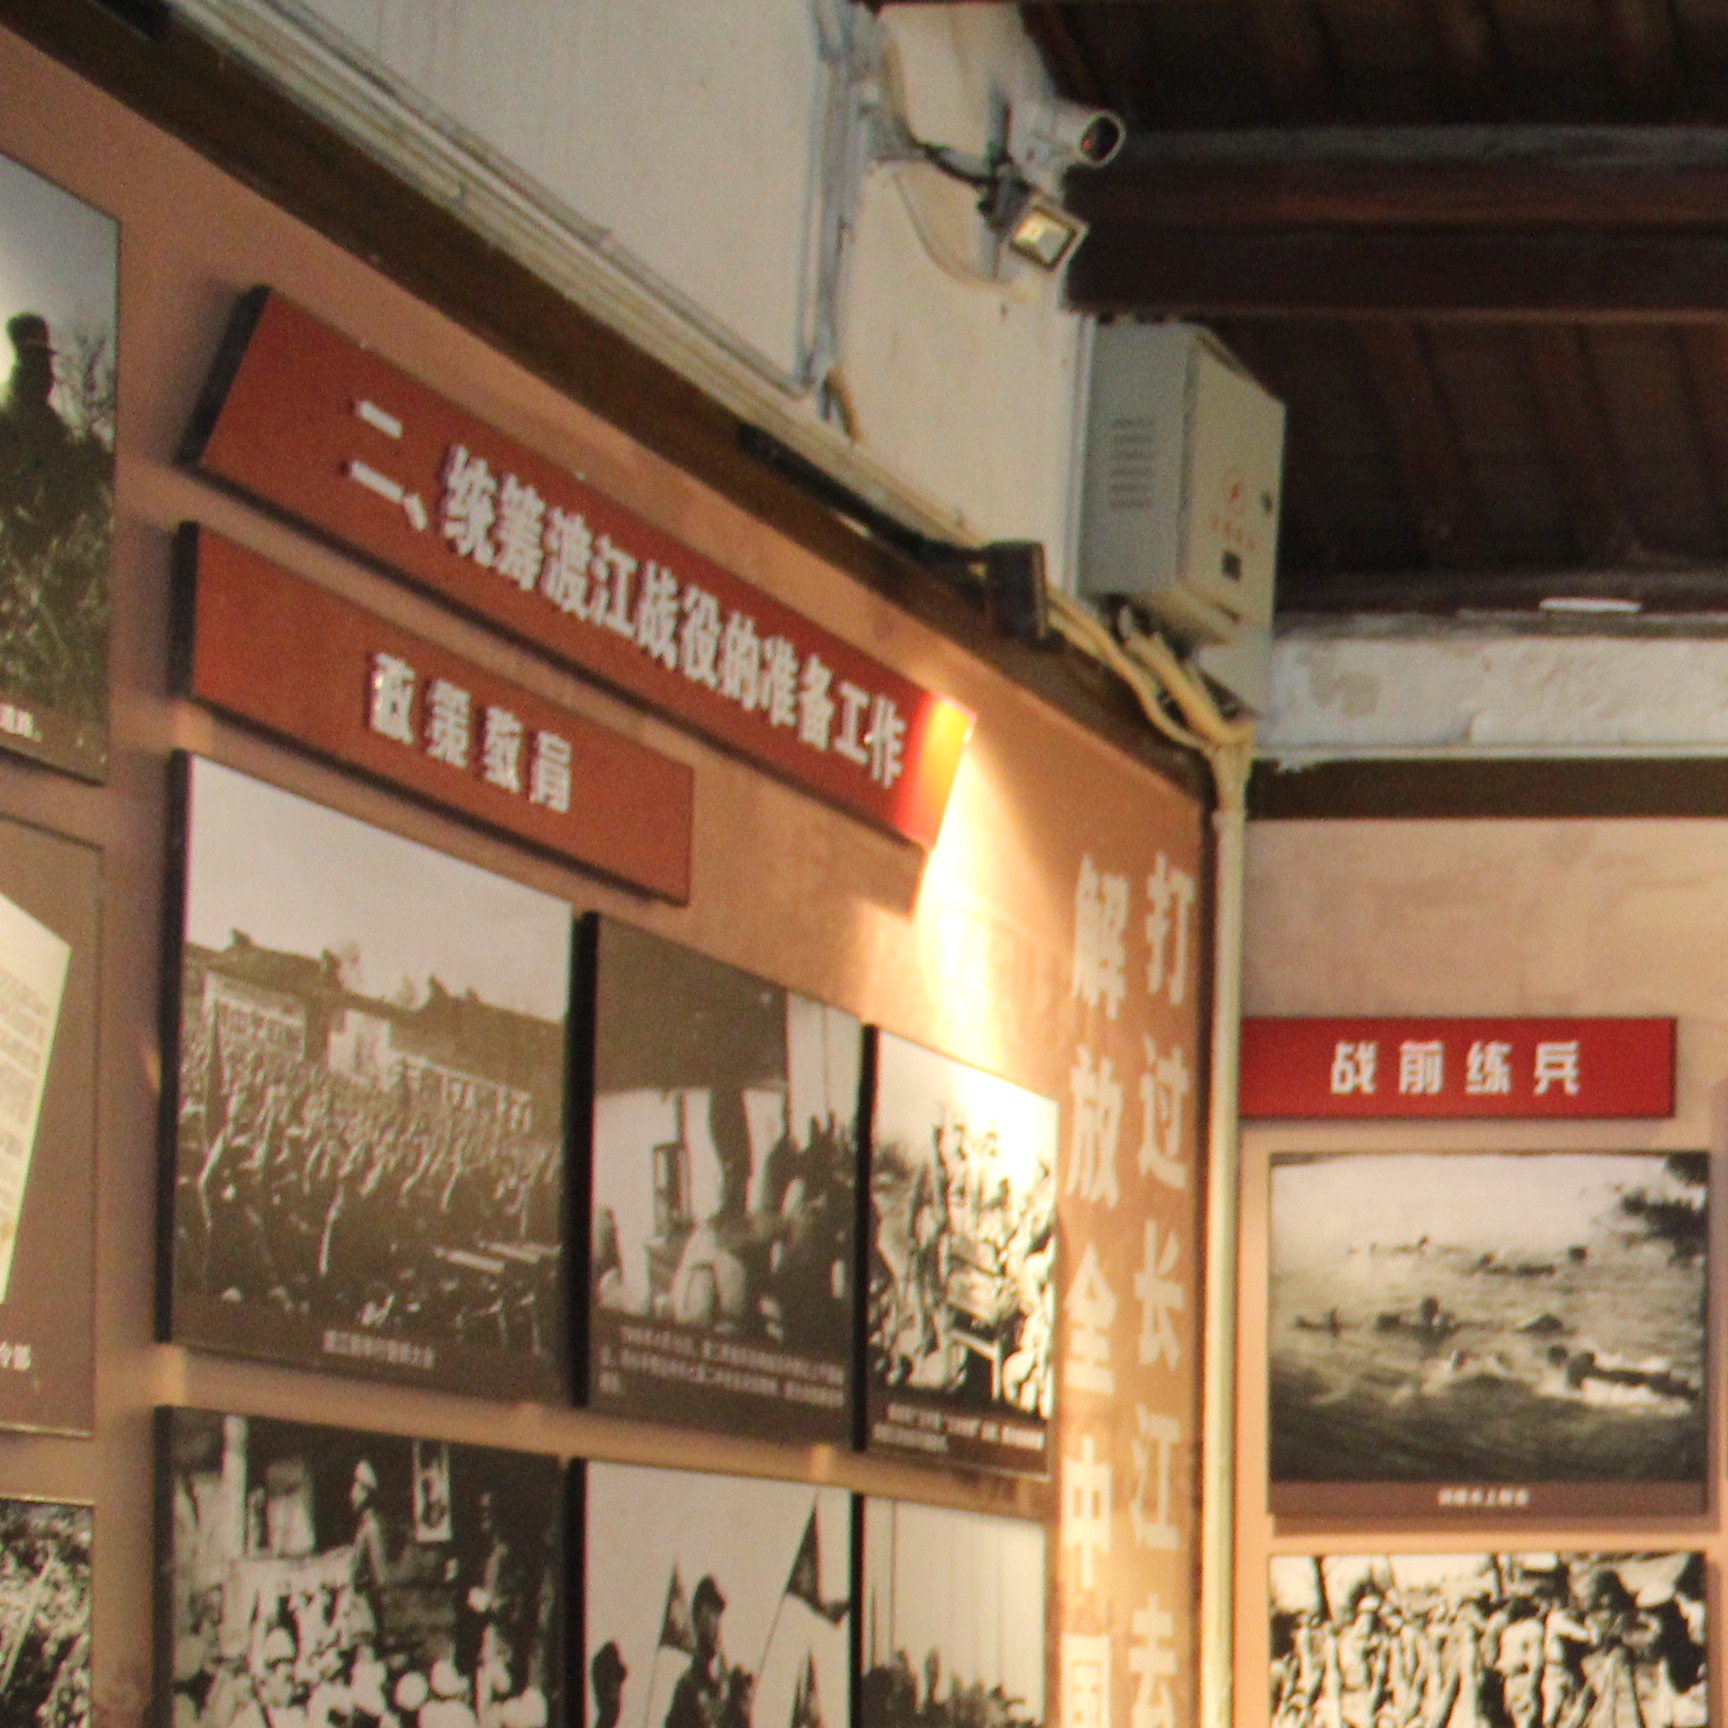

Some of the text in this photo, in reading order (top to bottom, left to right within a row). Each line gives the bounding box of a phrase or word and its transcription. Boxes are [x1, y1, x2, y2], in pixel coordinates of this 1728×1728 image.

[347, 399, 906, 788] 二、统筹渡江战役的准备工作
[369, 651, 574, 814] 政策教育
[1330, 1039, 1580, 1096] 战前练兵
